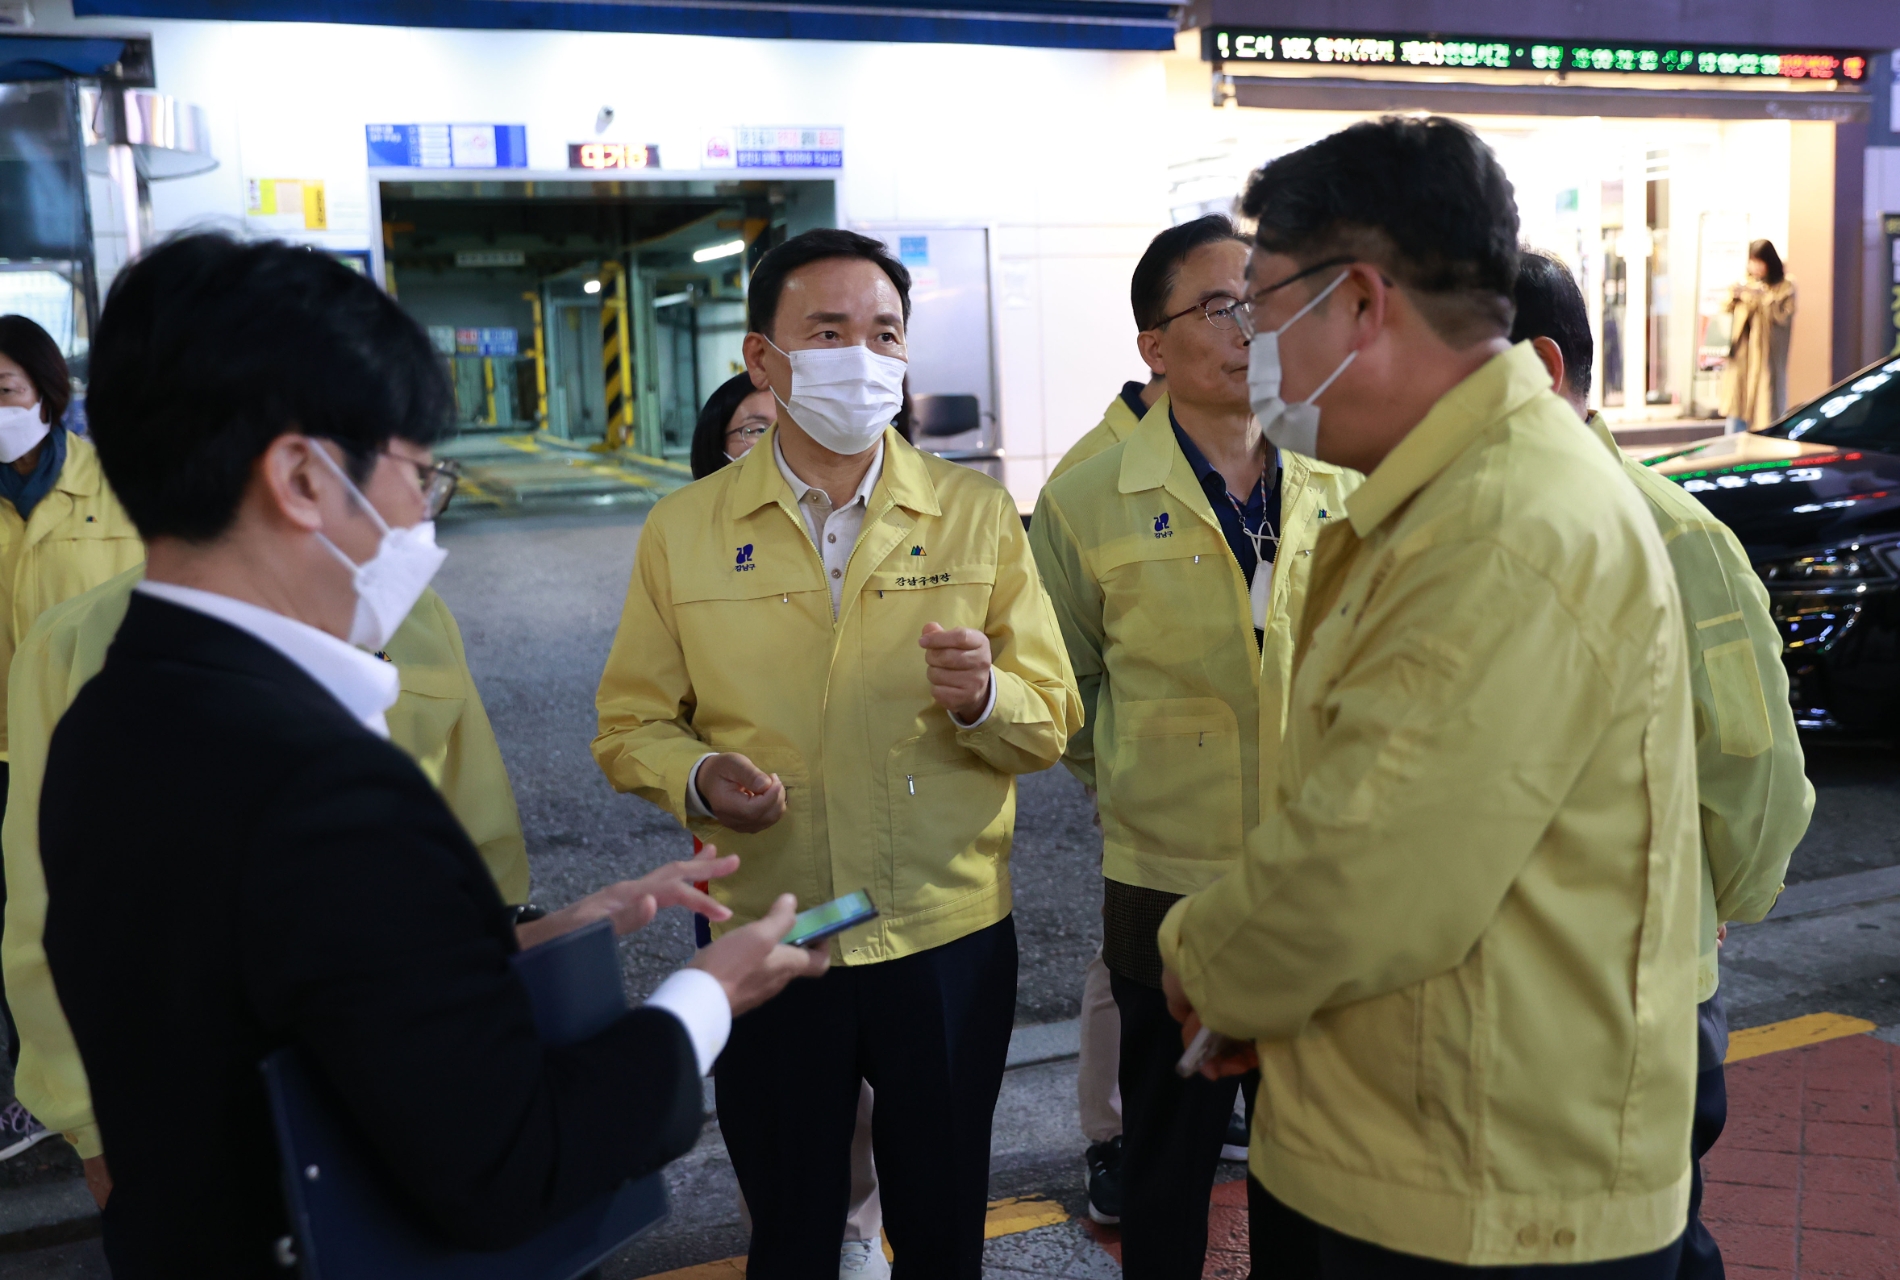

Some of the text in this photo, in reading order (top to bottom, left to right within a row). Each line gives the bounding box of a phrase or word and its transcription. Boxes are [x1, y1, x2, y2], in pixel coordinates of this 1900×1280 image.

[1154, 530, 1174, 539] 강남구
[735, 563, 756, 572] 강남구
[895, 572, 951, 587] 강남구청장
